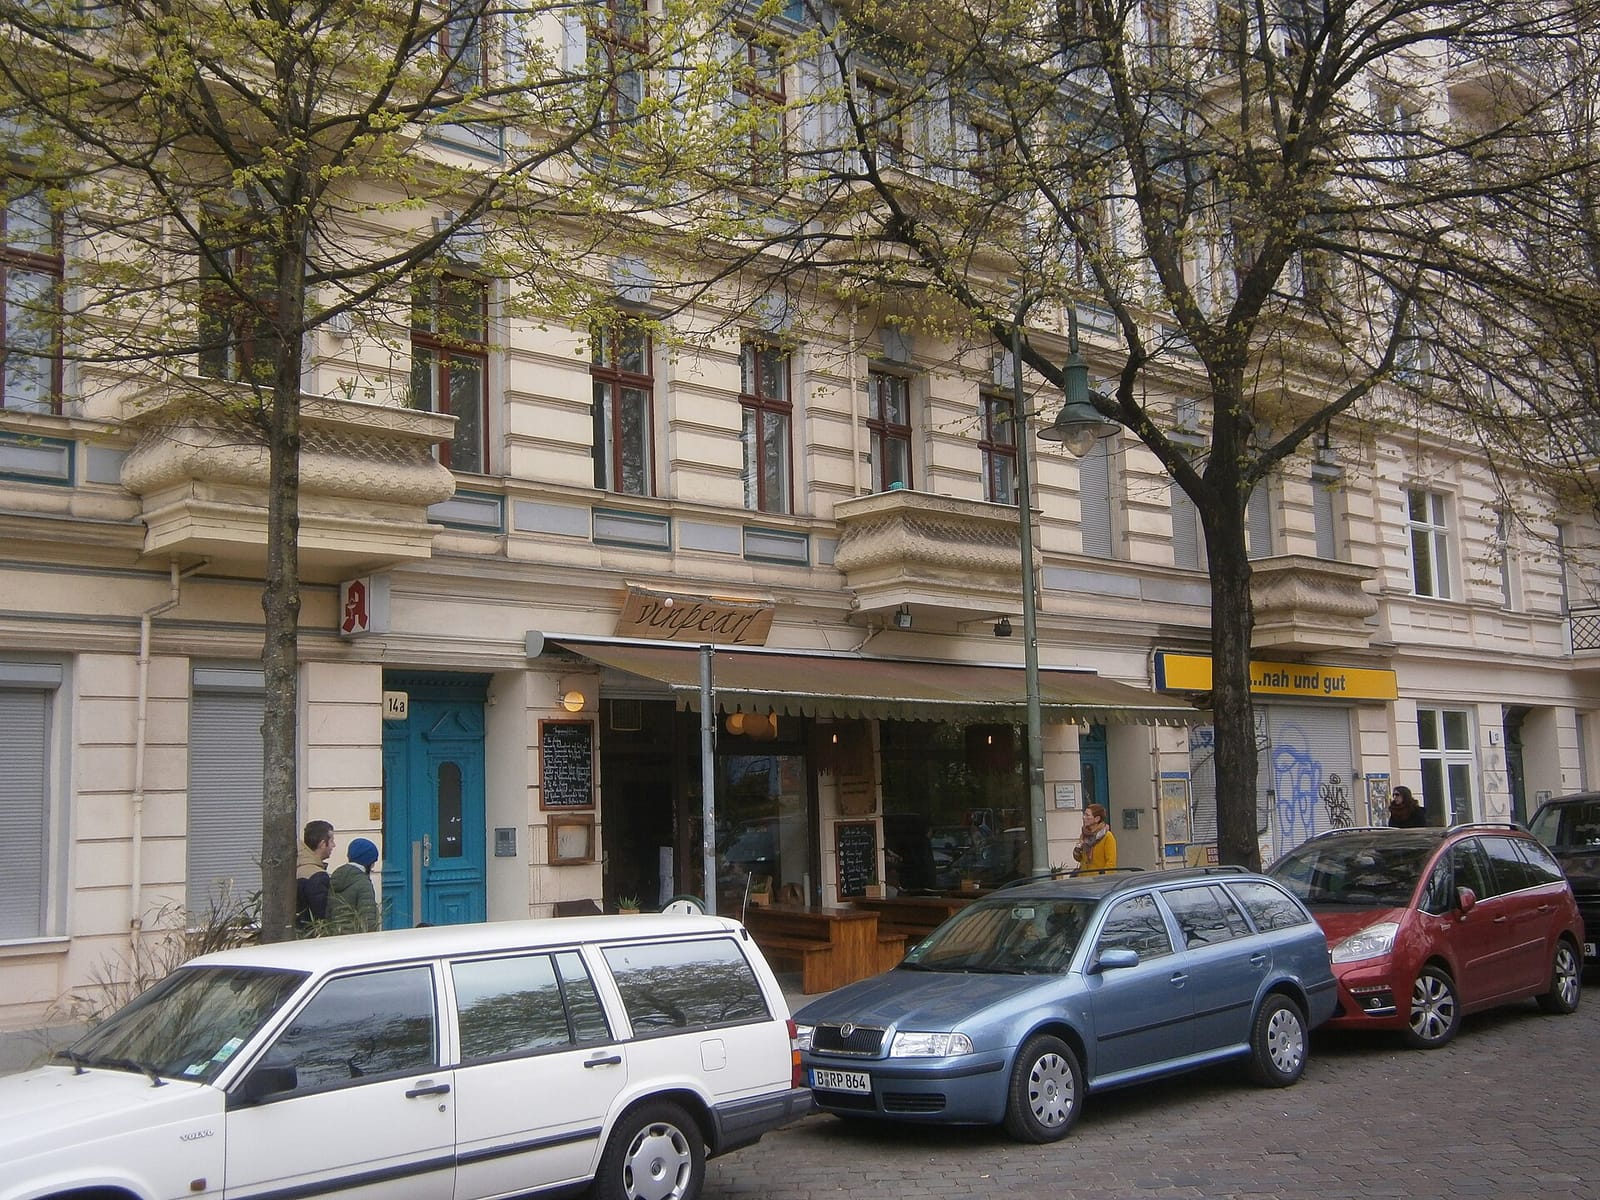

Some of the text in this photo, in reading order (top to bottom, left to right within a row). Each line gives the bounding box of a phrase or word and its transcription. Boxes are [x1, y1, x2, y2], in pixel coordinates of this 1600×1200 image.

[1294, 672, 1319, 689] und
[1324, 675, 1345, 694] gut
[388, 697, 405, 712] 14a
[817, 1071, 866, 1089] B RP 864
[180, 1129, 215, 1142] VOLVO
